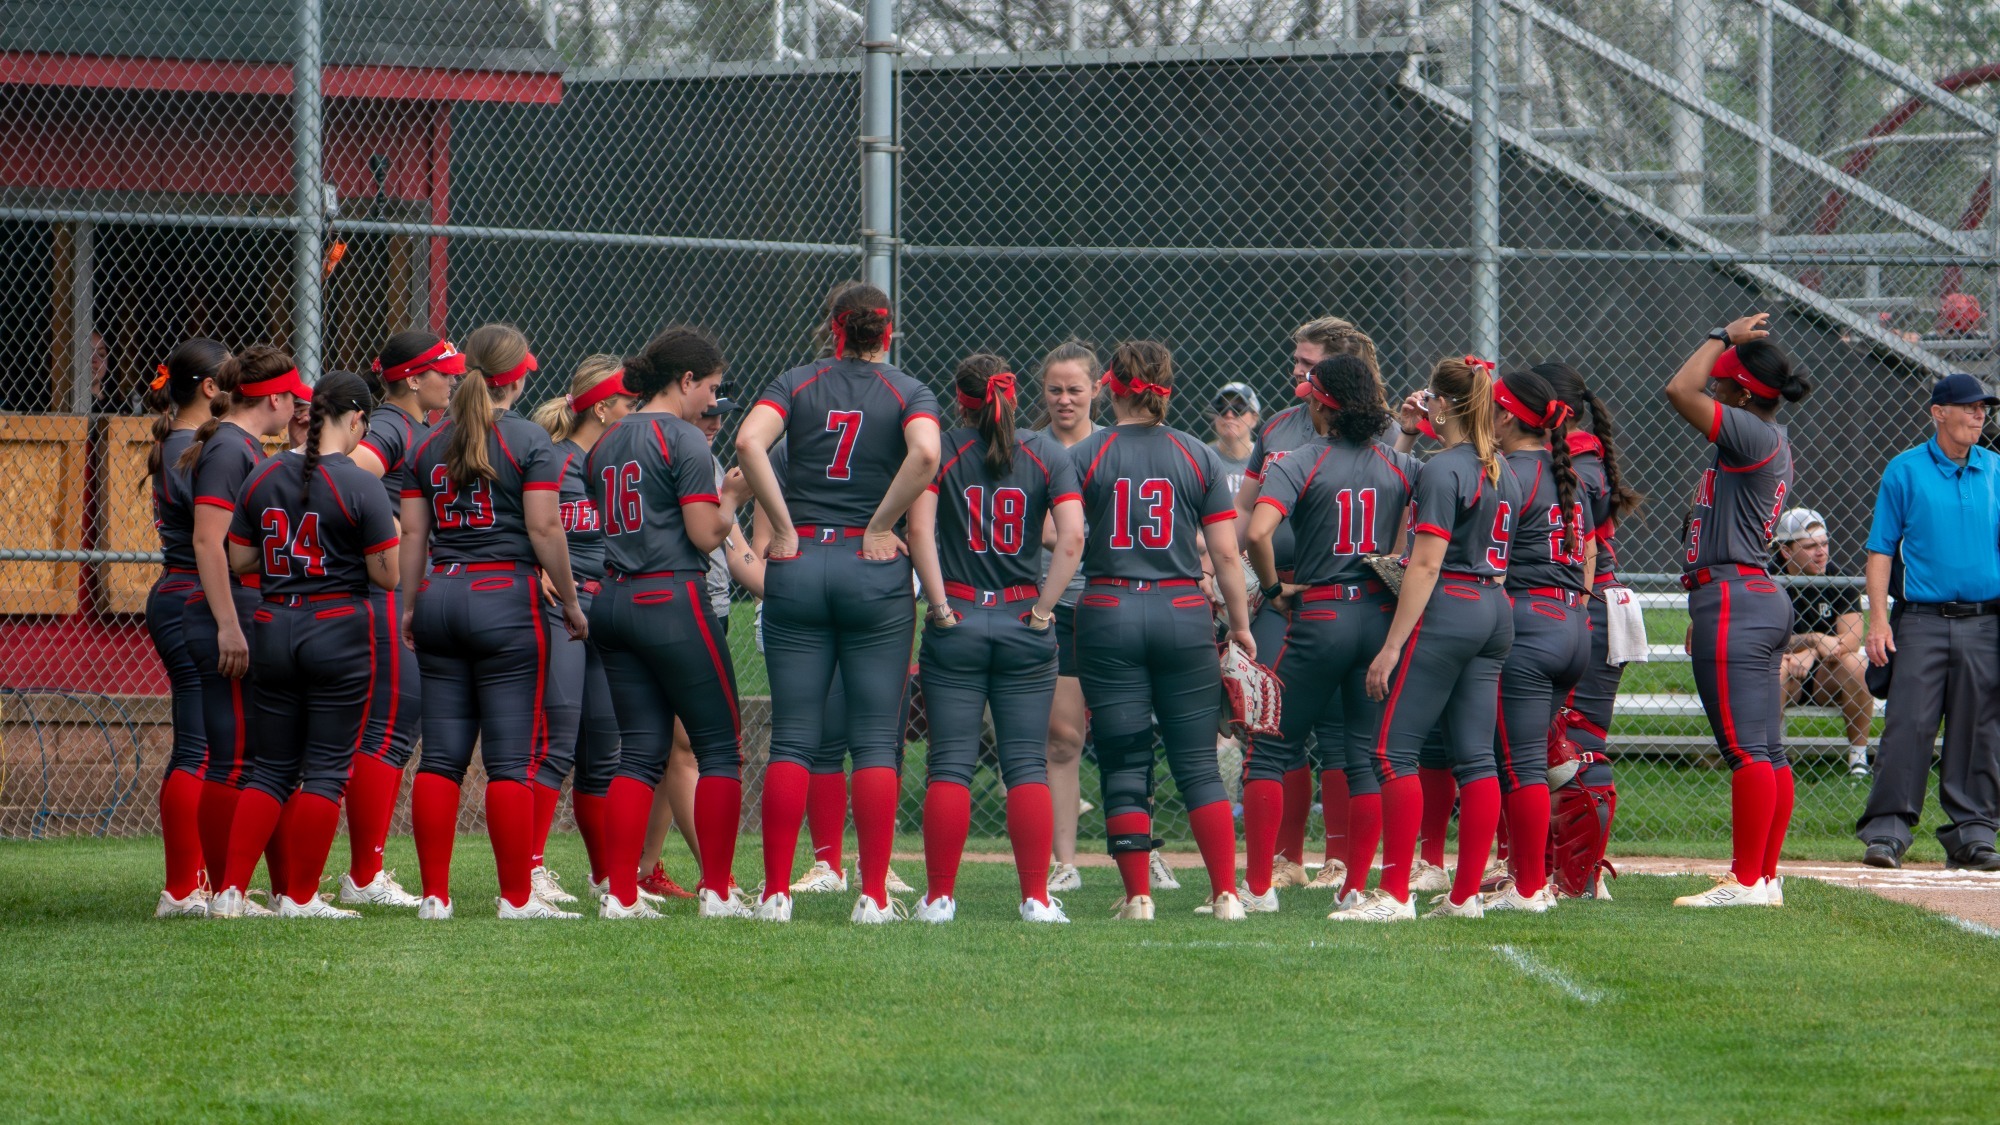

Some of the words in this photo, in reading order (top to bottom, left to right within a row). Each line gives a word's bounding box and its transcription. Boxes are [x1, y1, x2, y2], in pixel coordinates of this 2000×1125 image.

[825, 410, 863, 480] 7
[430, 464, 496, 530] 23
[601, 460, 643, 537] 16
[963, 485, 1027, 555] 18
[1109, 477, 1174, 550] 13
[1333, 488, 1377, 555] 11
[261, 507, 327, 578] 24
